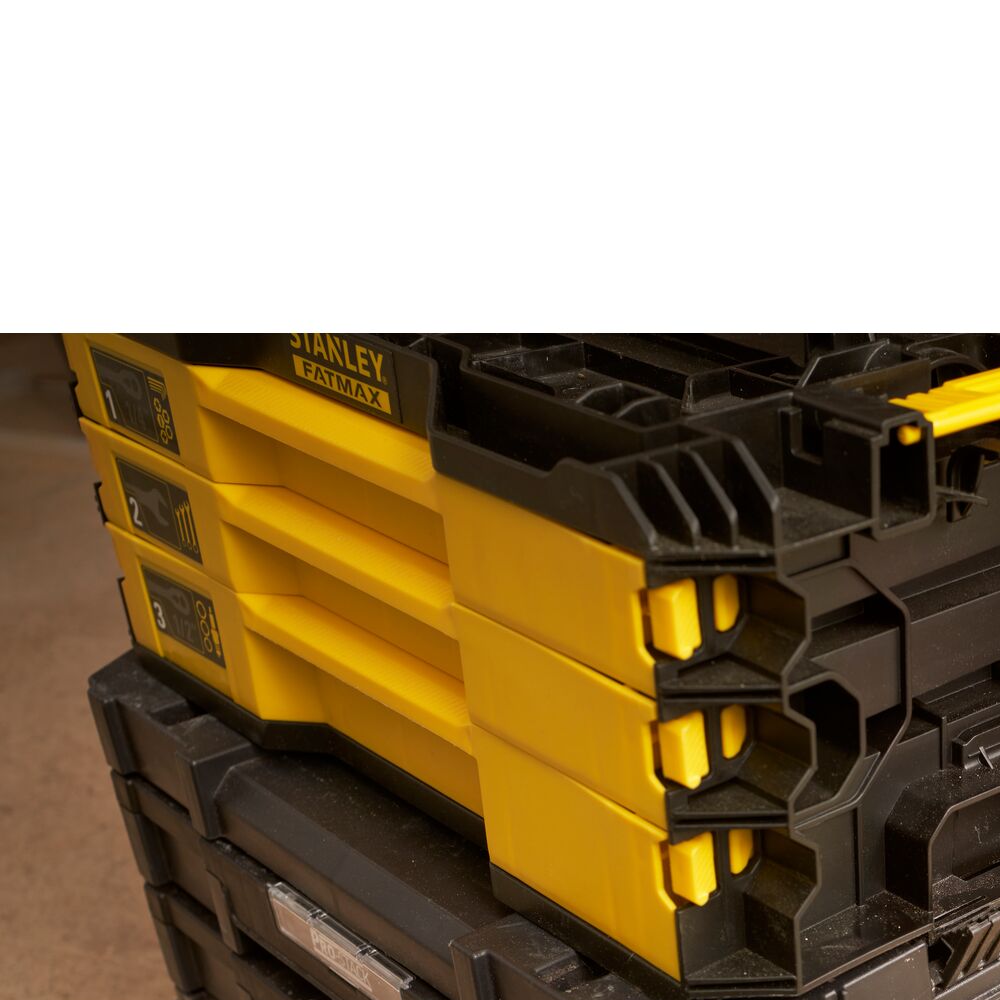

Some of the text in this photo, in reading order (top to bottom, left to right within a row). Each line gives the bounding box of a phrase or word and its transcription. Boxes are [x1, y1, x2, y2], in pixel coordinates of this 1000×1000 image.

[302, 359, 383, 408] FATMAX
[105, 389, 118, 420] 1
[129, 496, 143, 528] 2
[153, 601, 167, 630] 3
